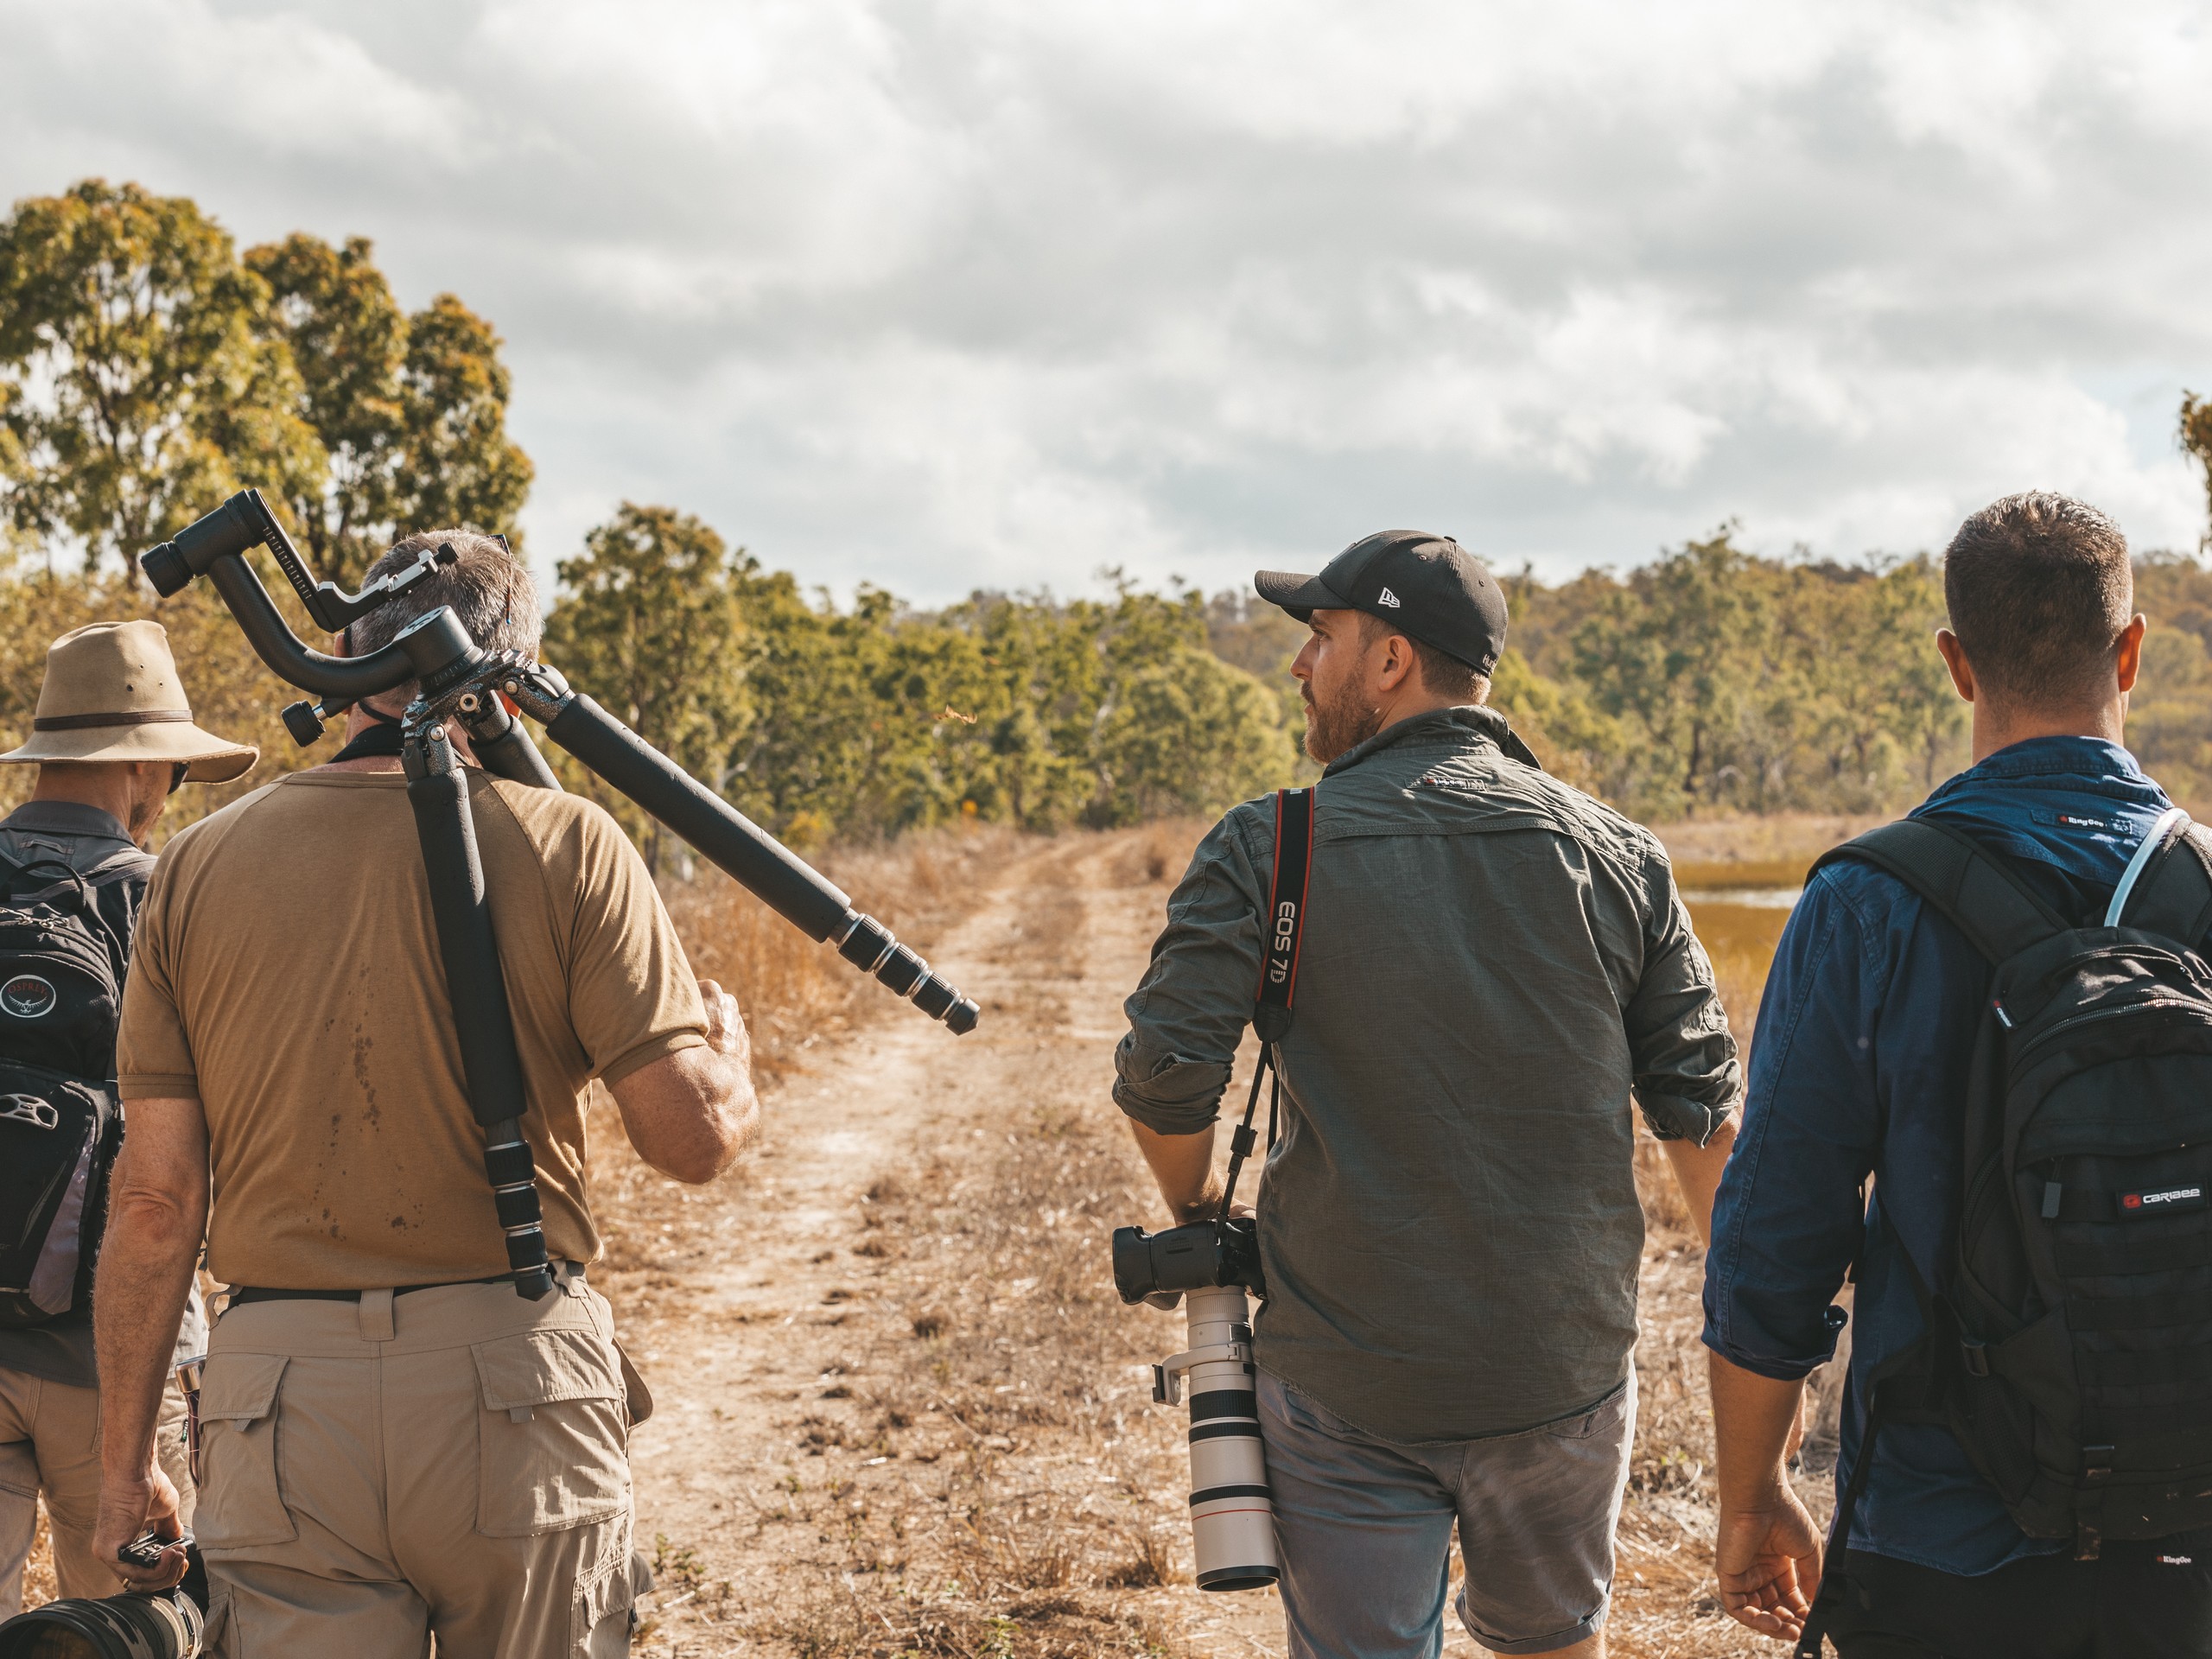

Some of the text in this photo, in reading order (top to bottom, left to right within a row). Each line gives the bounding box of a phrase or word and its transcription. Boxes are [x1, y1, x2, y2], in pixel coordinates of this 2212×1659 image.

[2069, 817, 2104, 827] KingGee
[1270, 901, 1295, 983] EOS 7D
[8, 982, 48, 995] OSPREY
[2164, 1555, 2191, 1565] KingGee
